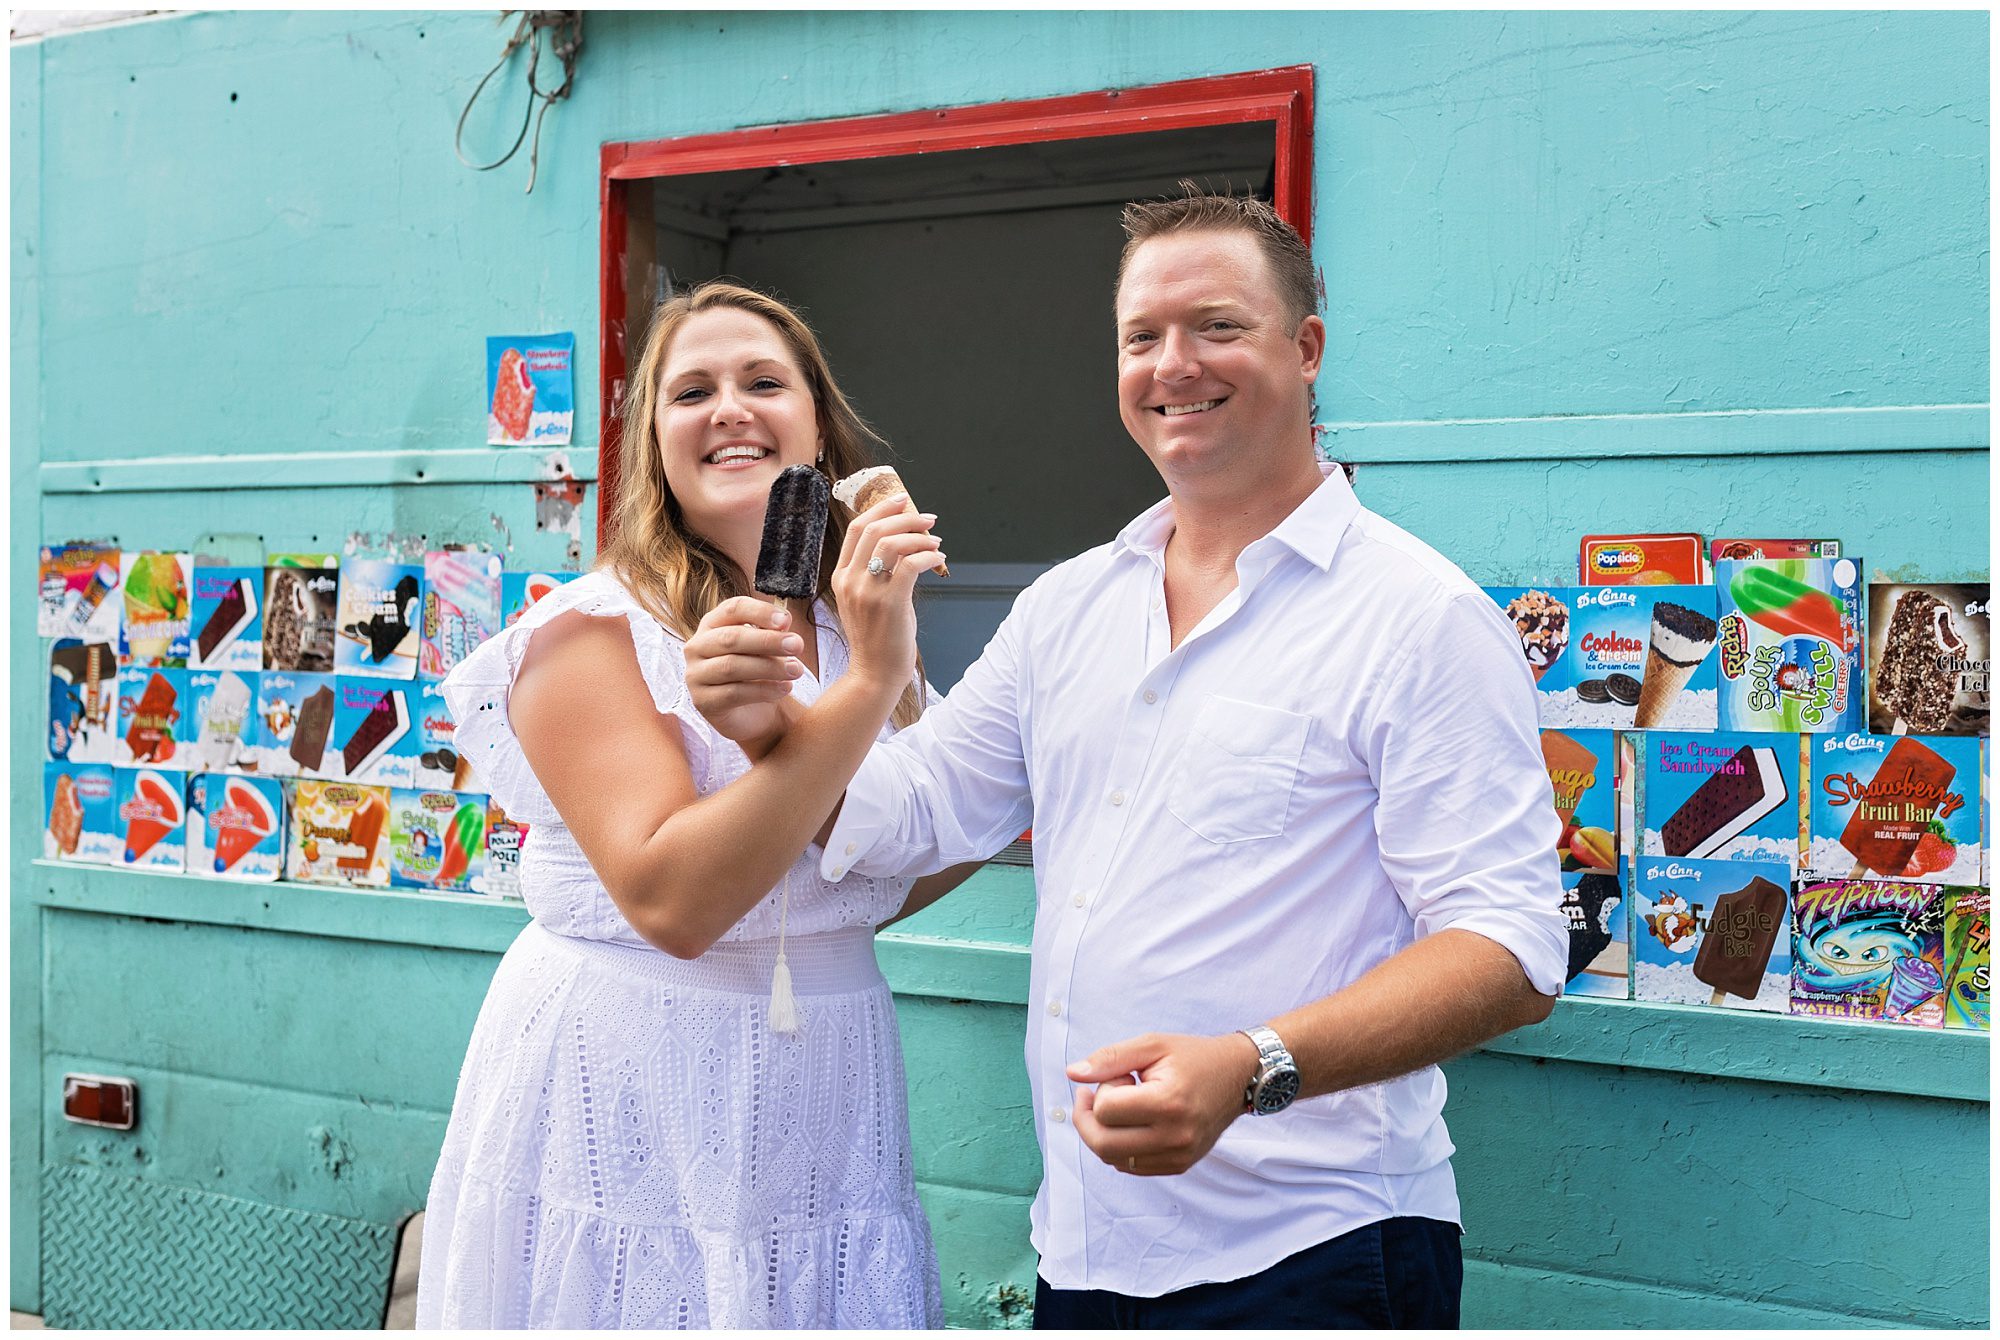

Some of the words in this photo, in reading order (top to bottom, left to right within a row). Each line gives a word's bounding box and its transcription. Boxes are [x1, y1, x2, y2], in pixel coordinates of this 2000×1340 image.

[1597, 551, 1639, 566] Popsicle
[1576, 588, 1637, 609] DeConna
[1580, 630, 1643, 652] Cookies
[1721, 615, 1751, 677] Rich's
[1597, 662, 1621, 670] Cream
[1622, 662, 1640, 670] Cone
[1598, 649, 1641, 662] Cream
[1748, 646, 1782, 711] SOUR
[1802, 641, 1831, 725] SWELL
[1833, 658, 1848, 712] CHERRY
[1660, 741, 1683, 755] Ice
[1687, 741, 1736, 757] Cream
[1823, 733, 1885, 752] DeConna
[1660, 755, 1746, 776] Sandwich
[1547, 768, 1596, 798] ngo
[1823, 767, 1965, 818] Strawberry
[1860, 800, 1900, 821] Fruit
[1905, 802, 1933, 823] Bar
[1874, 831, 1896, 839] REAL
[1897, 832, 1921, 840] FRUIT
[1647, 863, 1702, 881] DeConna
[1796, 880, 1937, 939] TYPHOON
[1566, 921, 1588, 930] BAR
[1690, 901, 1774, 941] Fudgie
[1724, 935, 1756, 958] Bar
[1791, 1002, 1846, 1016] WATER
[1849, 1005, 1873, 1018] ICE
